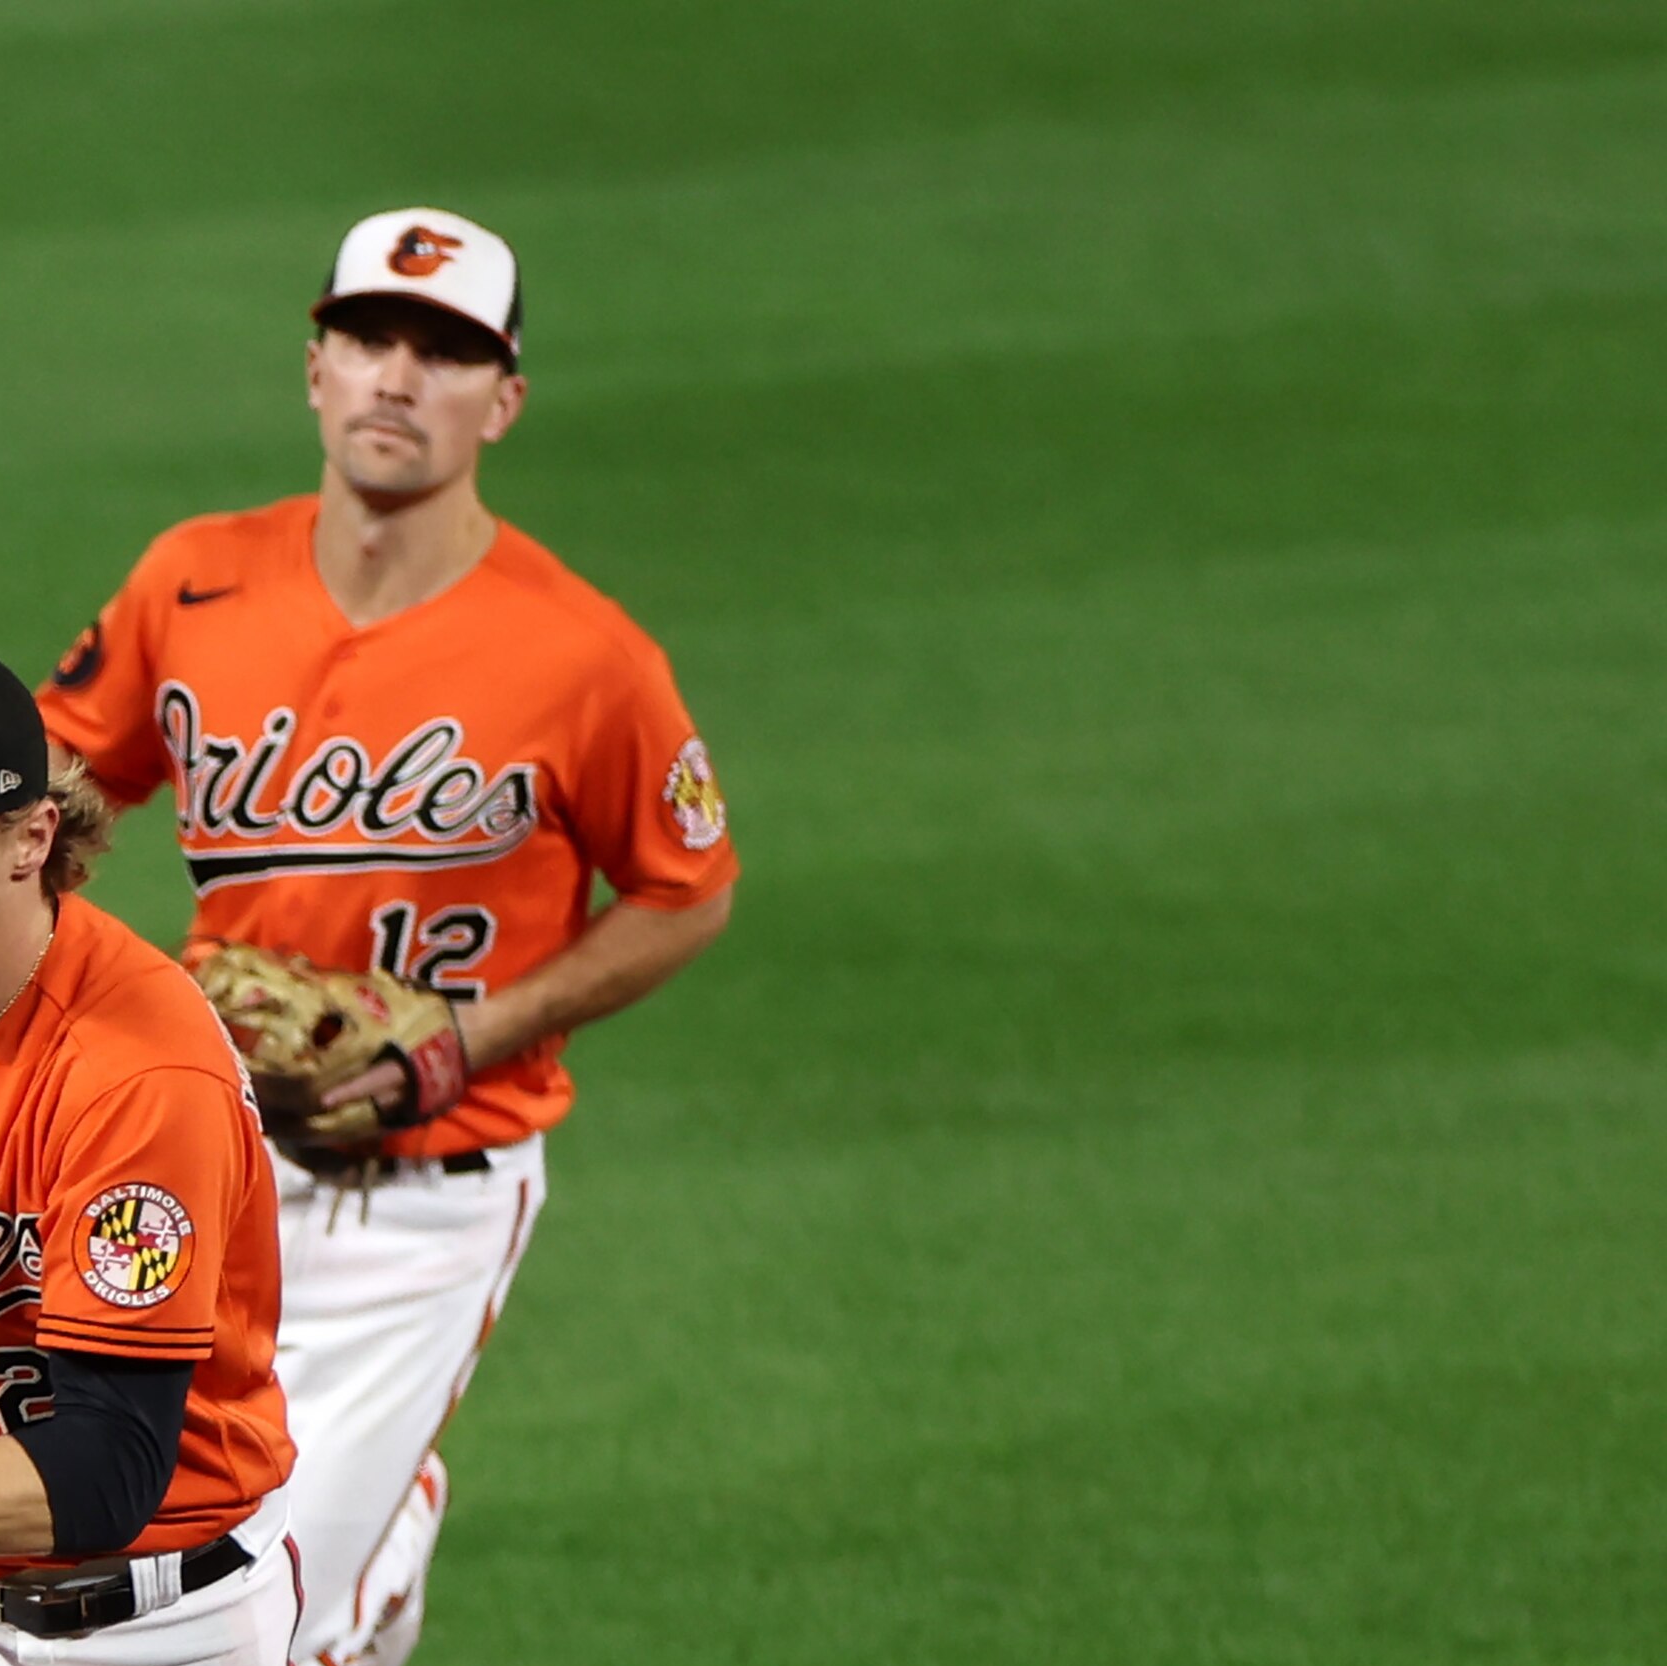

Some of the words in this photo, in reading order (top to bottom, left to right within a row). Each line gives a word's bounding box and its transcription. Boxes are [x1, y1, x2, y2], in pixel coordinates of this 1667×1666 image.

[369, 899, 498, 1004] 12
[84, 1183, 192, 1237] BALTIMORE
[83, 1269, 172, 1307] ORIOLES
